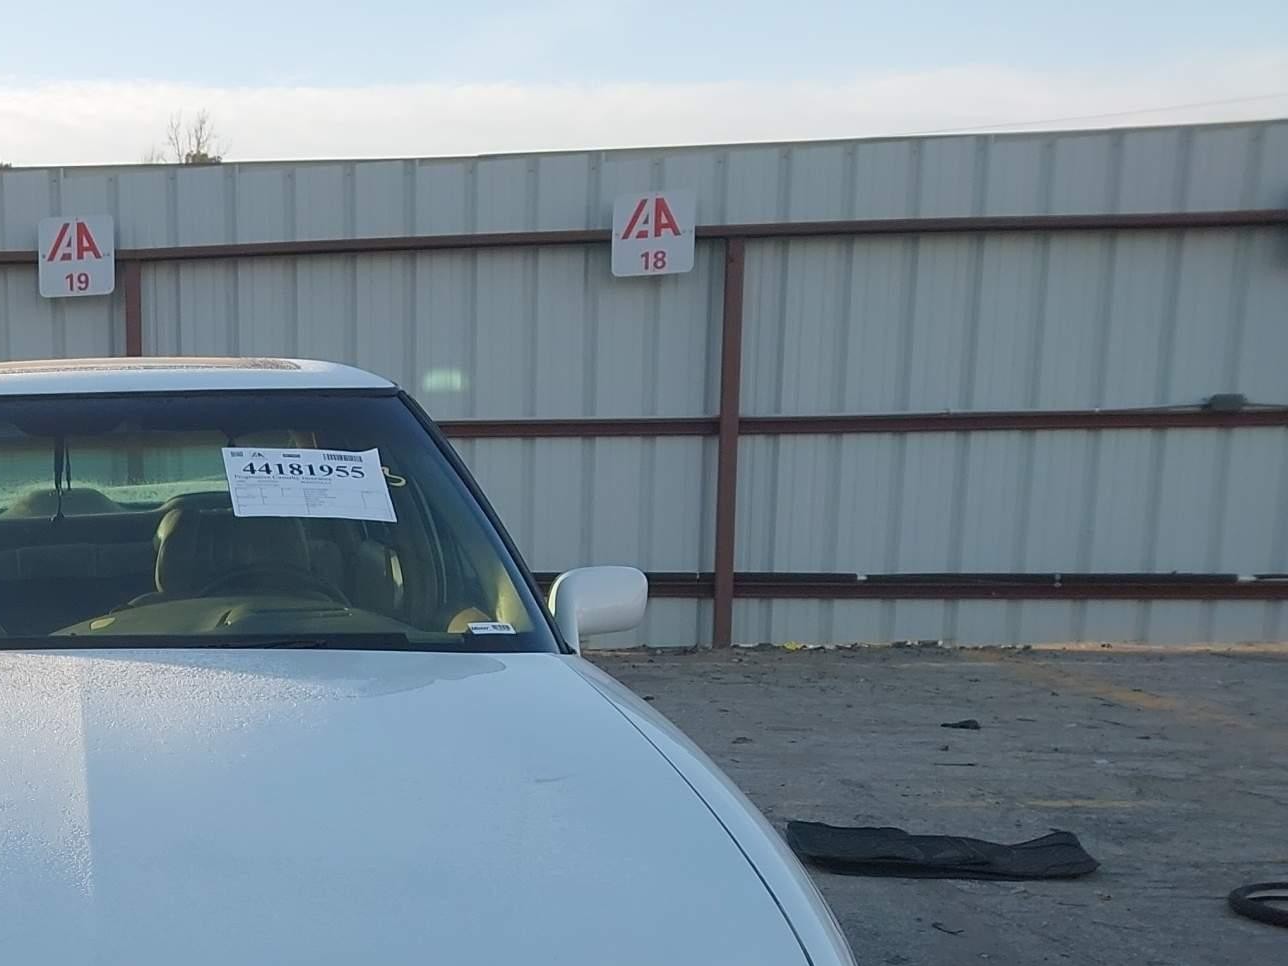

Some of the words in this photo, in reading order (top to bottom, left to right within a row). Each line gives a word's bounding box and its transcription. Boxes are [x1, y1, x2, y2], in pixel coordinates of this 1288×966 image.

[640, 250, 667, 271] 18
[65, 272, 90, 292] 19
[242, 461, 365, 479] 44181955
